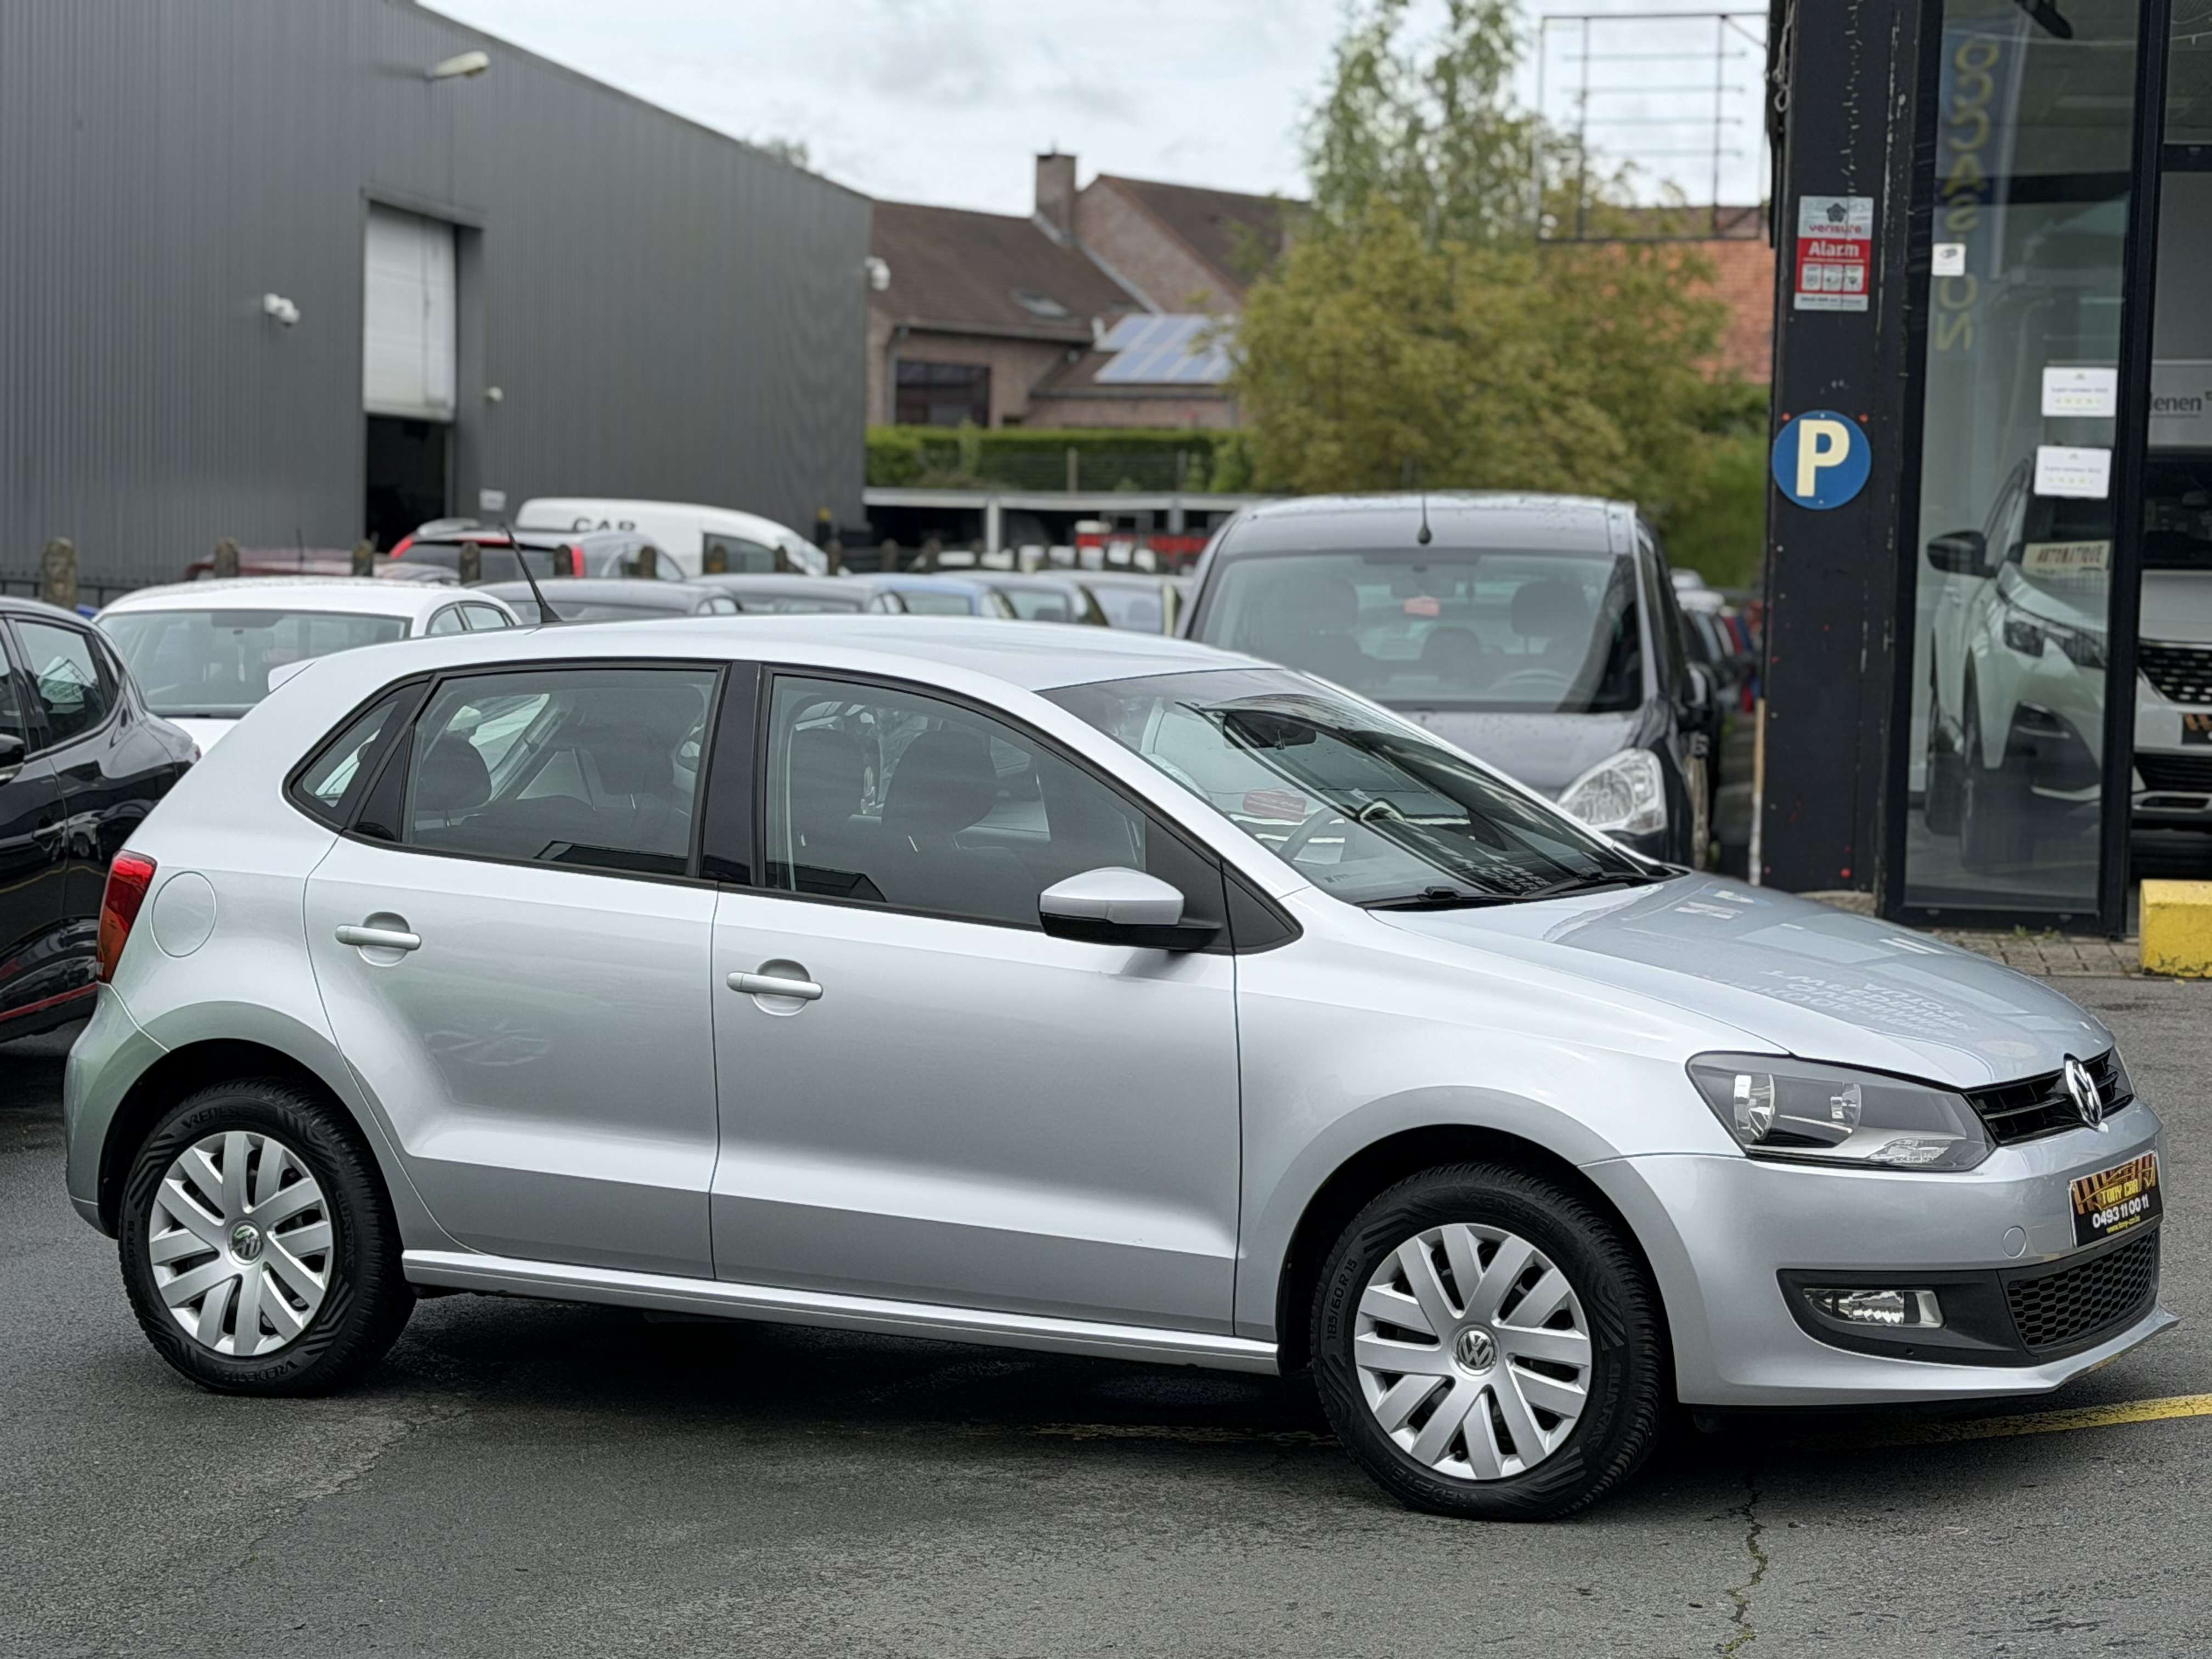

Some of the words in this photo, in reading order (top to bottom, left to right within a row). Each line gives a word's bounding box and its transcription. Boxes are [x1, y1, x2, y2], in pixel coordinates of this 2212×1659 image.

[1809, 224, 1861, 234] verisure
[1809, 241, 1860, 257] Alarm
[1796, 419, 1850, 497] P
[2092, 1207, 2119, 1228] 0493
[1327, 1288, 1345, 1341] 185/60
[1340, 1274, 1351, 1287] R
[1346, 1259, 1358, 1273] 15
